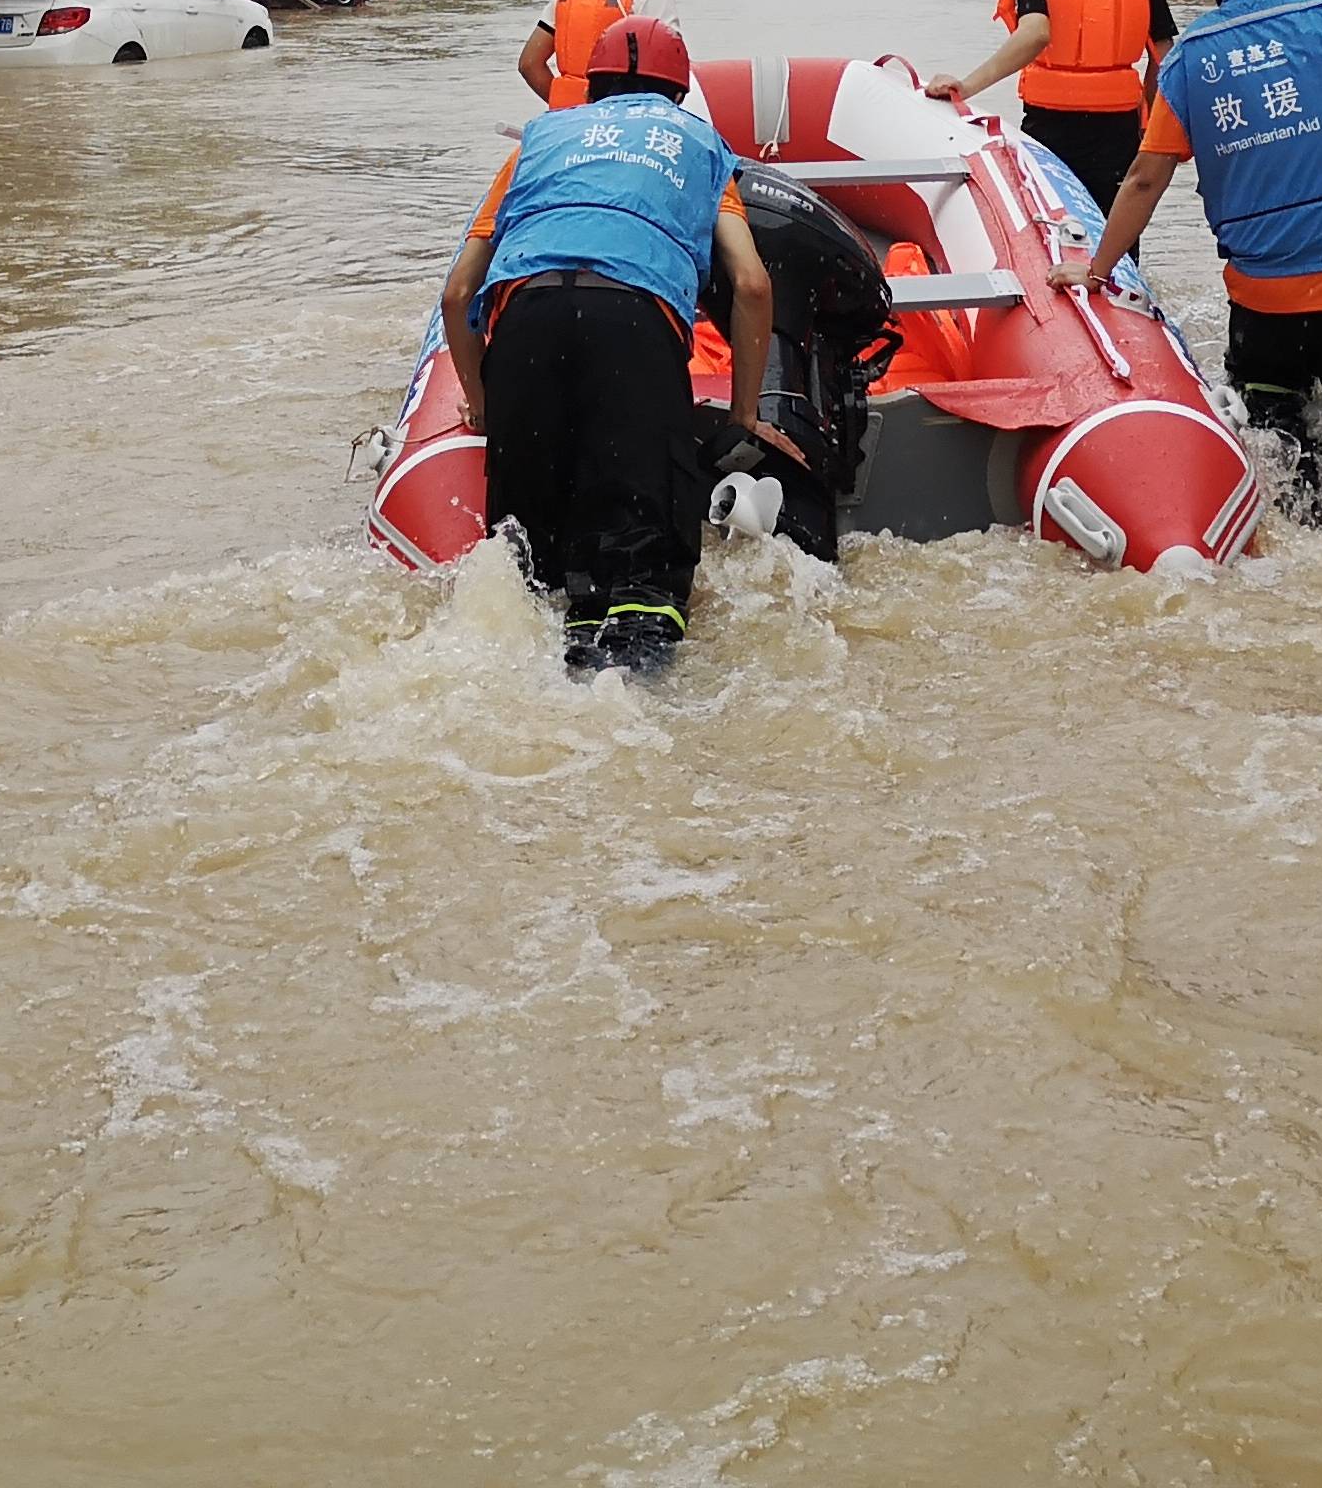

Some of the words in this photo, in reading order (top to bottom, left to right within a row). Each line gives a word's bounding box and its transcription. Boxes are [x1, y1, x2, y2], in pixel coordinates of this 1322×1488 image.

[1227, 39, 1285, 68] 壹基金
[1211, 77, 1303, 133] 救援
[581, 123, 684, 164] 救援
[1215, 124, 1297, 156] Humanitarian
[1298, 116, 1321, 136] Aid
[564, 149, 664, 176] Humanitarian
[663, 167, 685, 190] Aid
